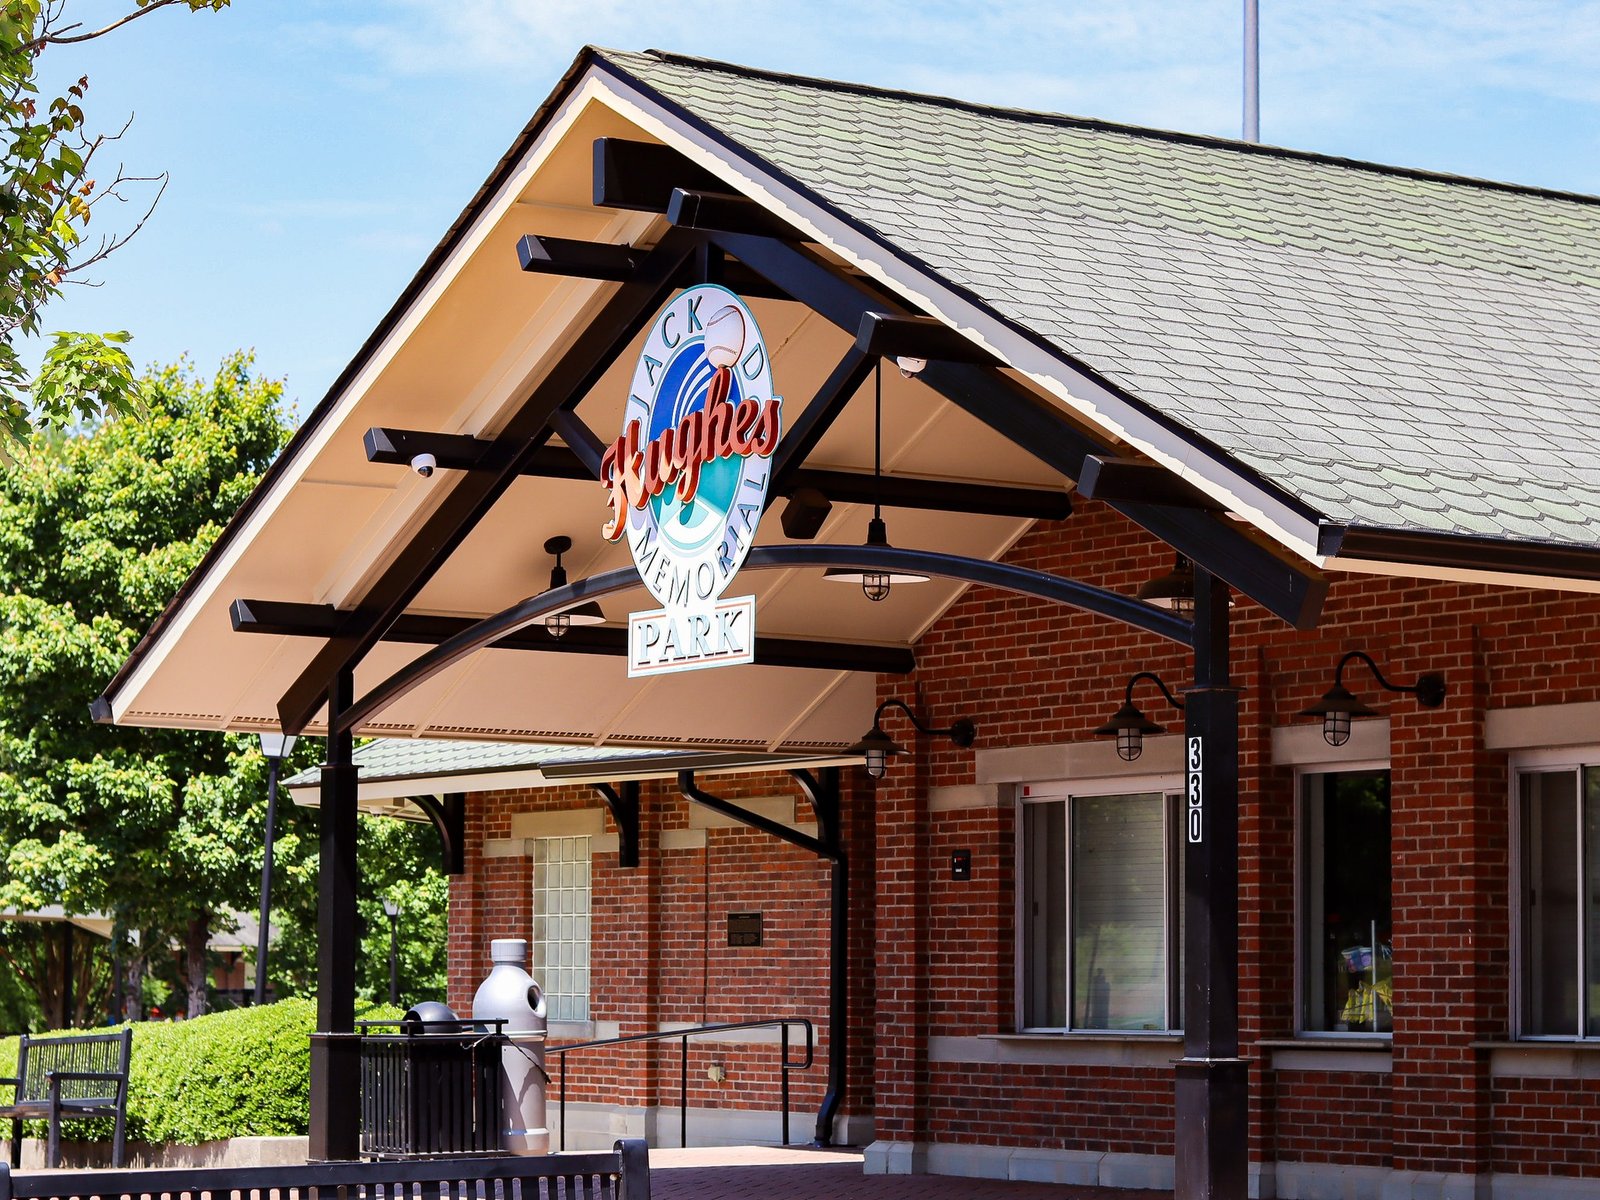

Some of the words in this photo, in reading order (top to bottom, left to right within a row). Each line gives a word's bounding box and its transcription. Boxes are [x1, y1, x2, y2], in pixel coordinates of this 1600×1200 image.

[631, 295, 703, 416] JACK
[741, 343, 764, 380] D
[601, 367, 780, 542] Hughes
[635, 472, 767, 608] MEMORIAL
[637, 610, 743, 665] PARK
[1189, 737, 1202, 842] 330
